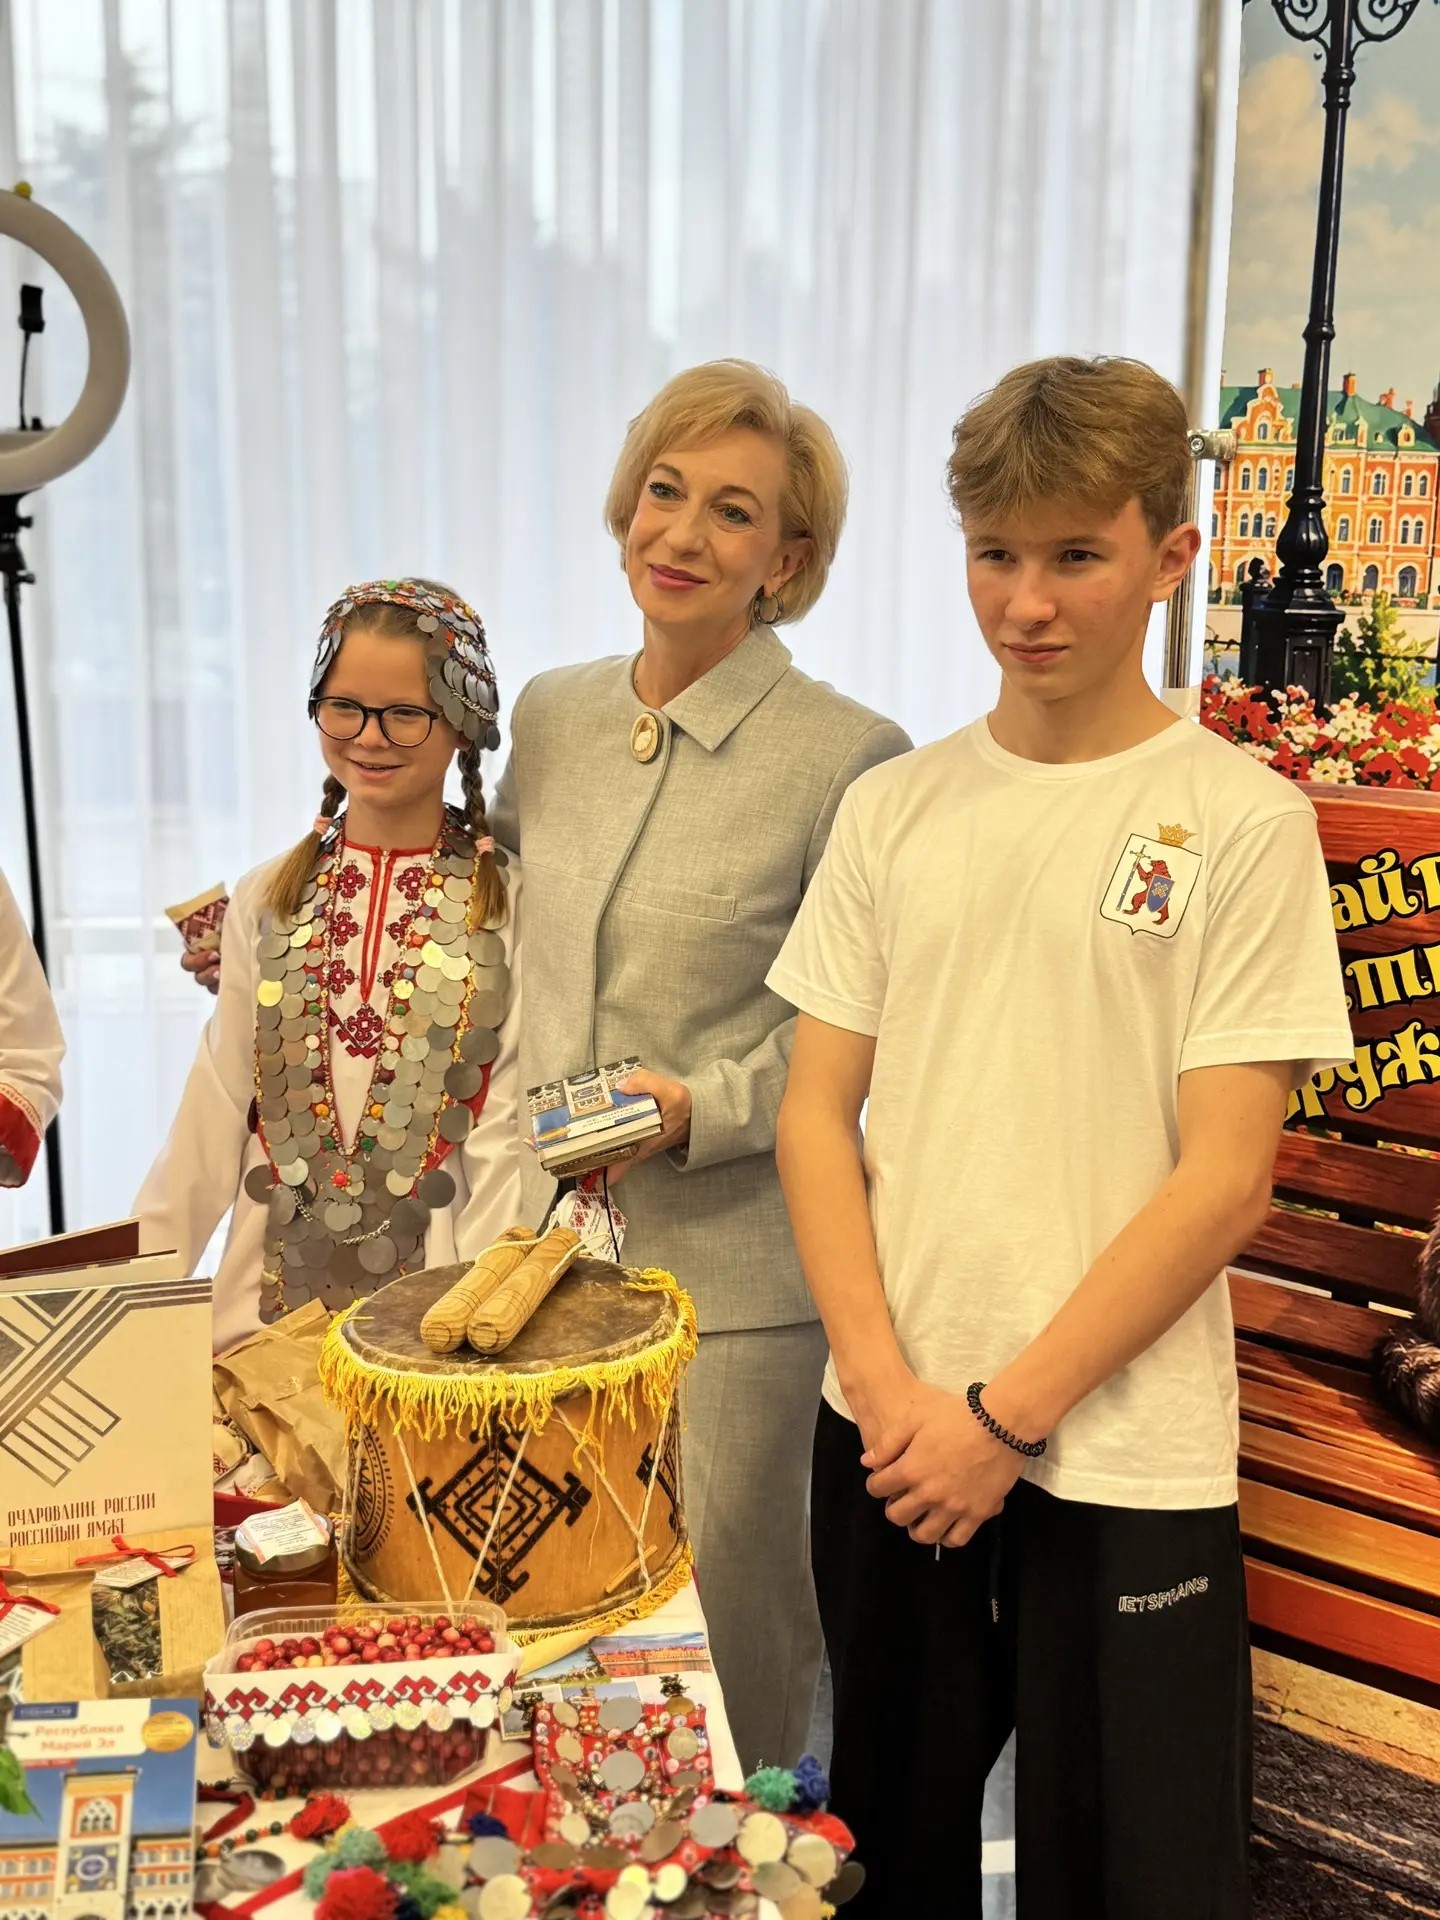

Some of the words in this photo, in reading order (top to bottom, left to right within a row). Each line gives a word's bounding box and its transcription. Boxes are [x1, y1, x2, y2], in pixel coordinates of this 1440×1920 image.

[8, 1500, 96, 1528] ОЧАРОВАНИЕ
[104, 1492, 156, 1515] РОССИИ
[35, 1724, 124, 1739] Республика
[41, 1738, 92, 1752] Марий
